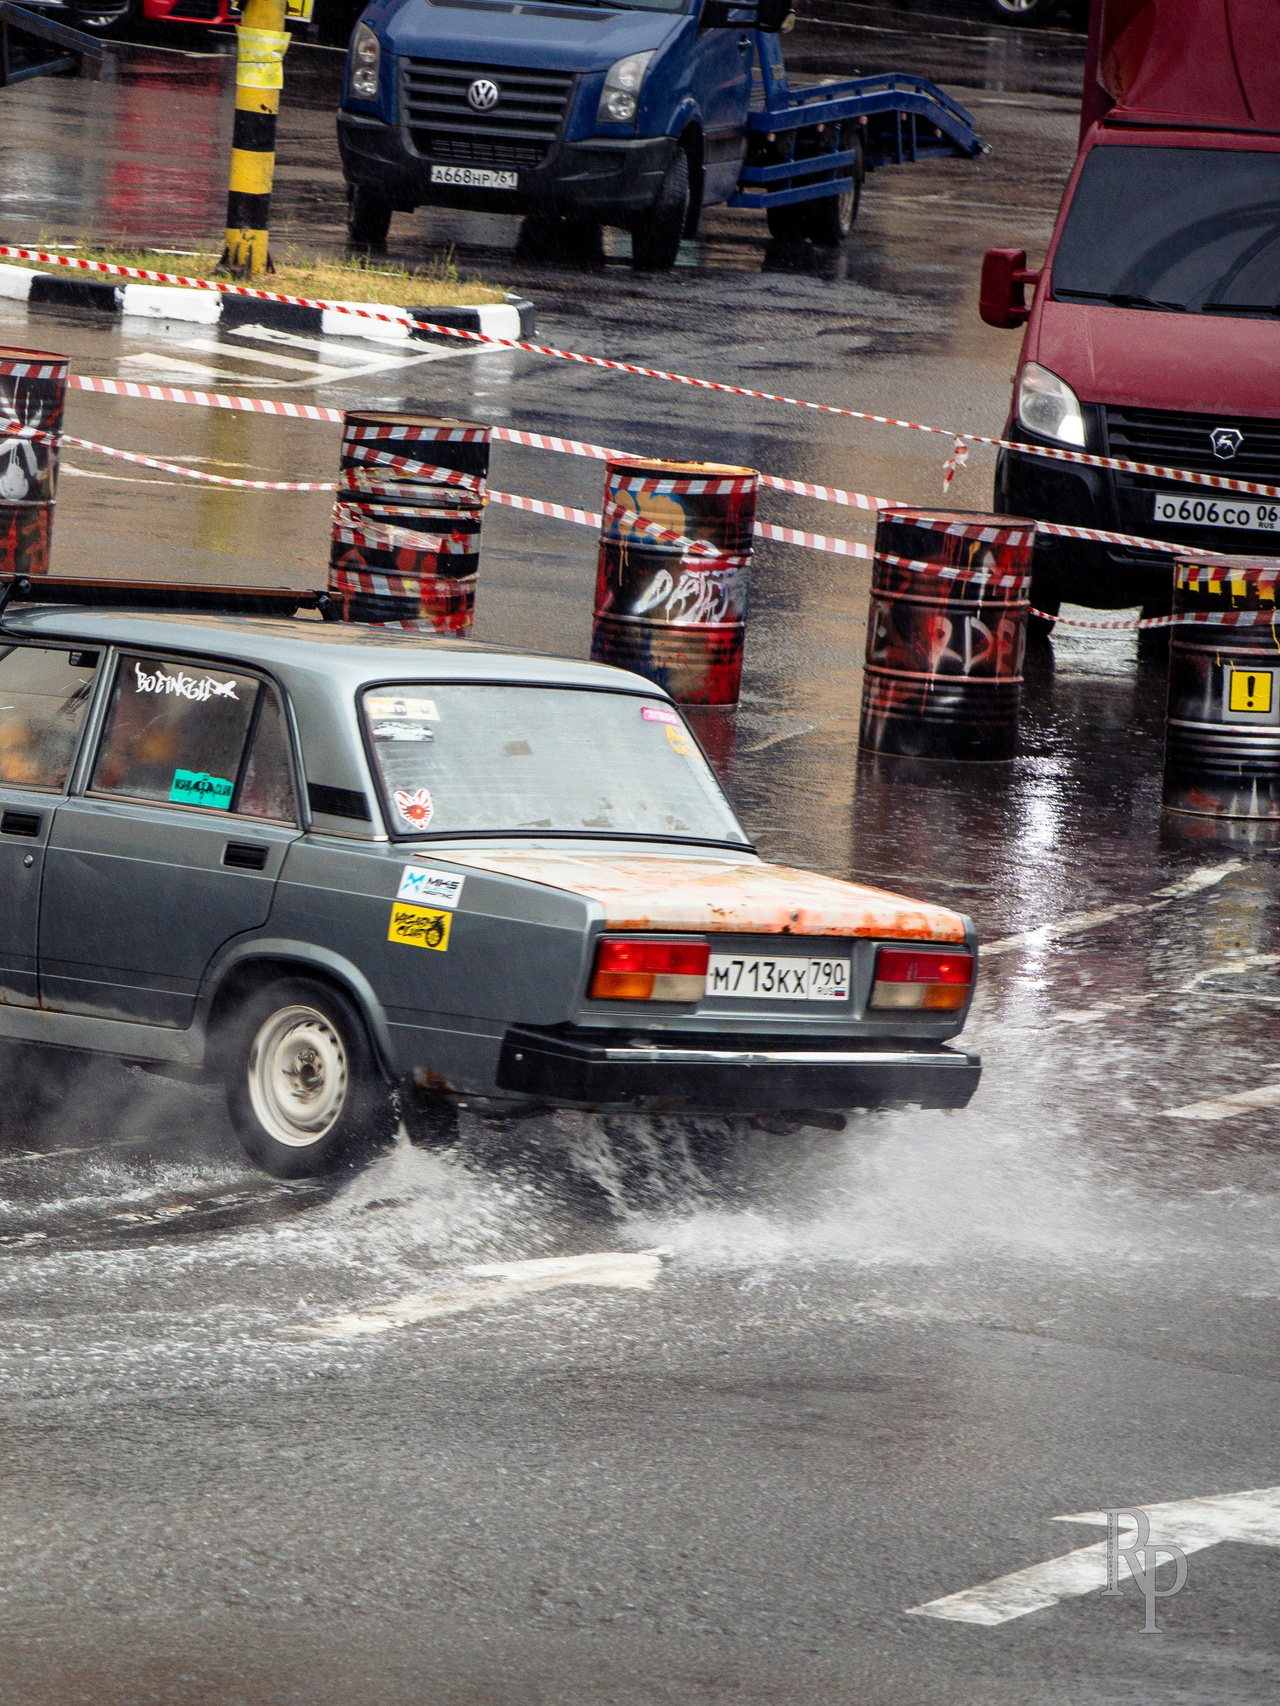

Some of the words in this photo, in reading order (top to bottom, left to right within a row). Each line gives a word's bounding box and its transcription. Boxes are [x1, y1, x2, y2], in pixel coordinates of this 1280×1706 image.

[1257, 505, 1278, 522] 06
[1258, 521, 1275, 530] RUS
[811, 961, 846, 986] 790
